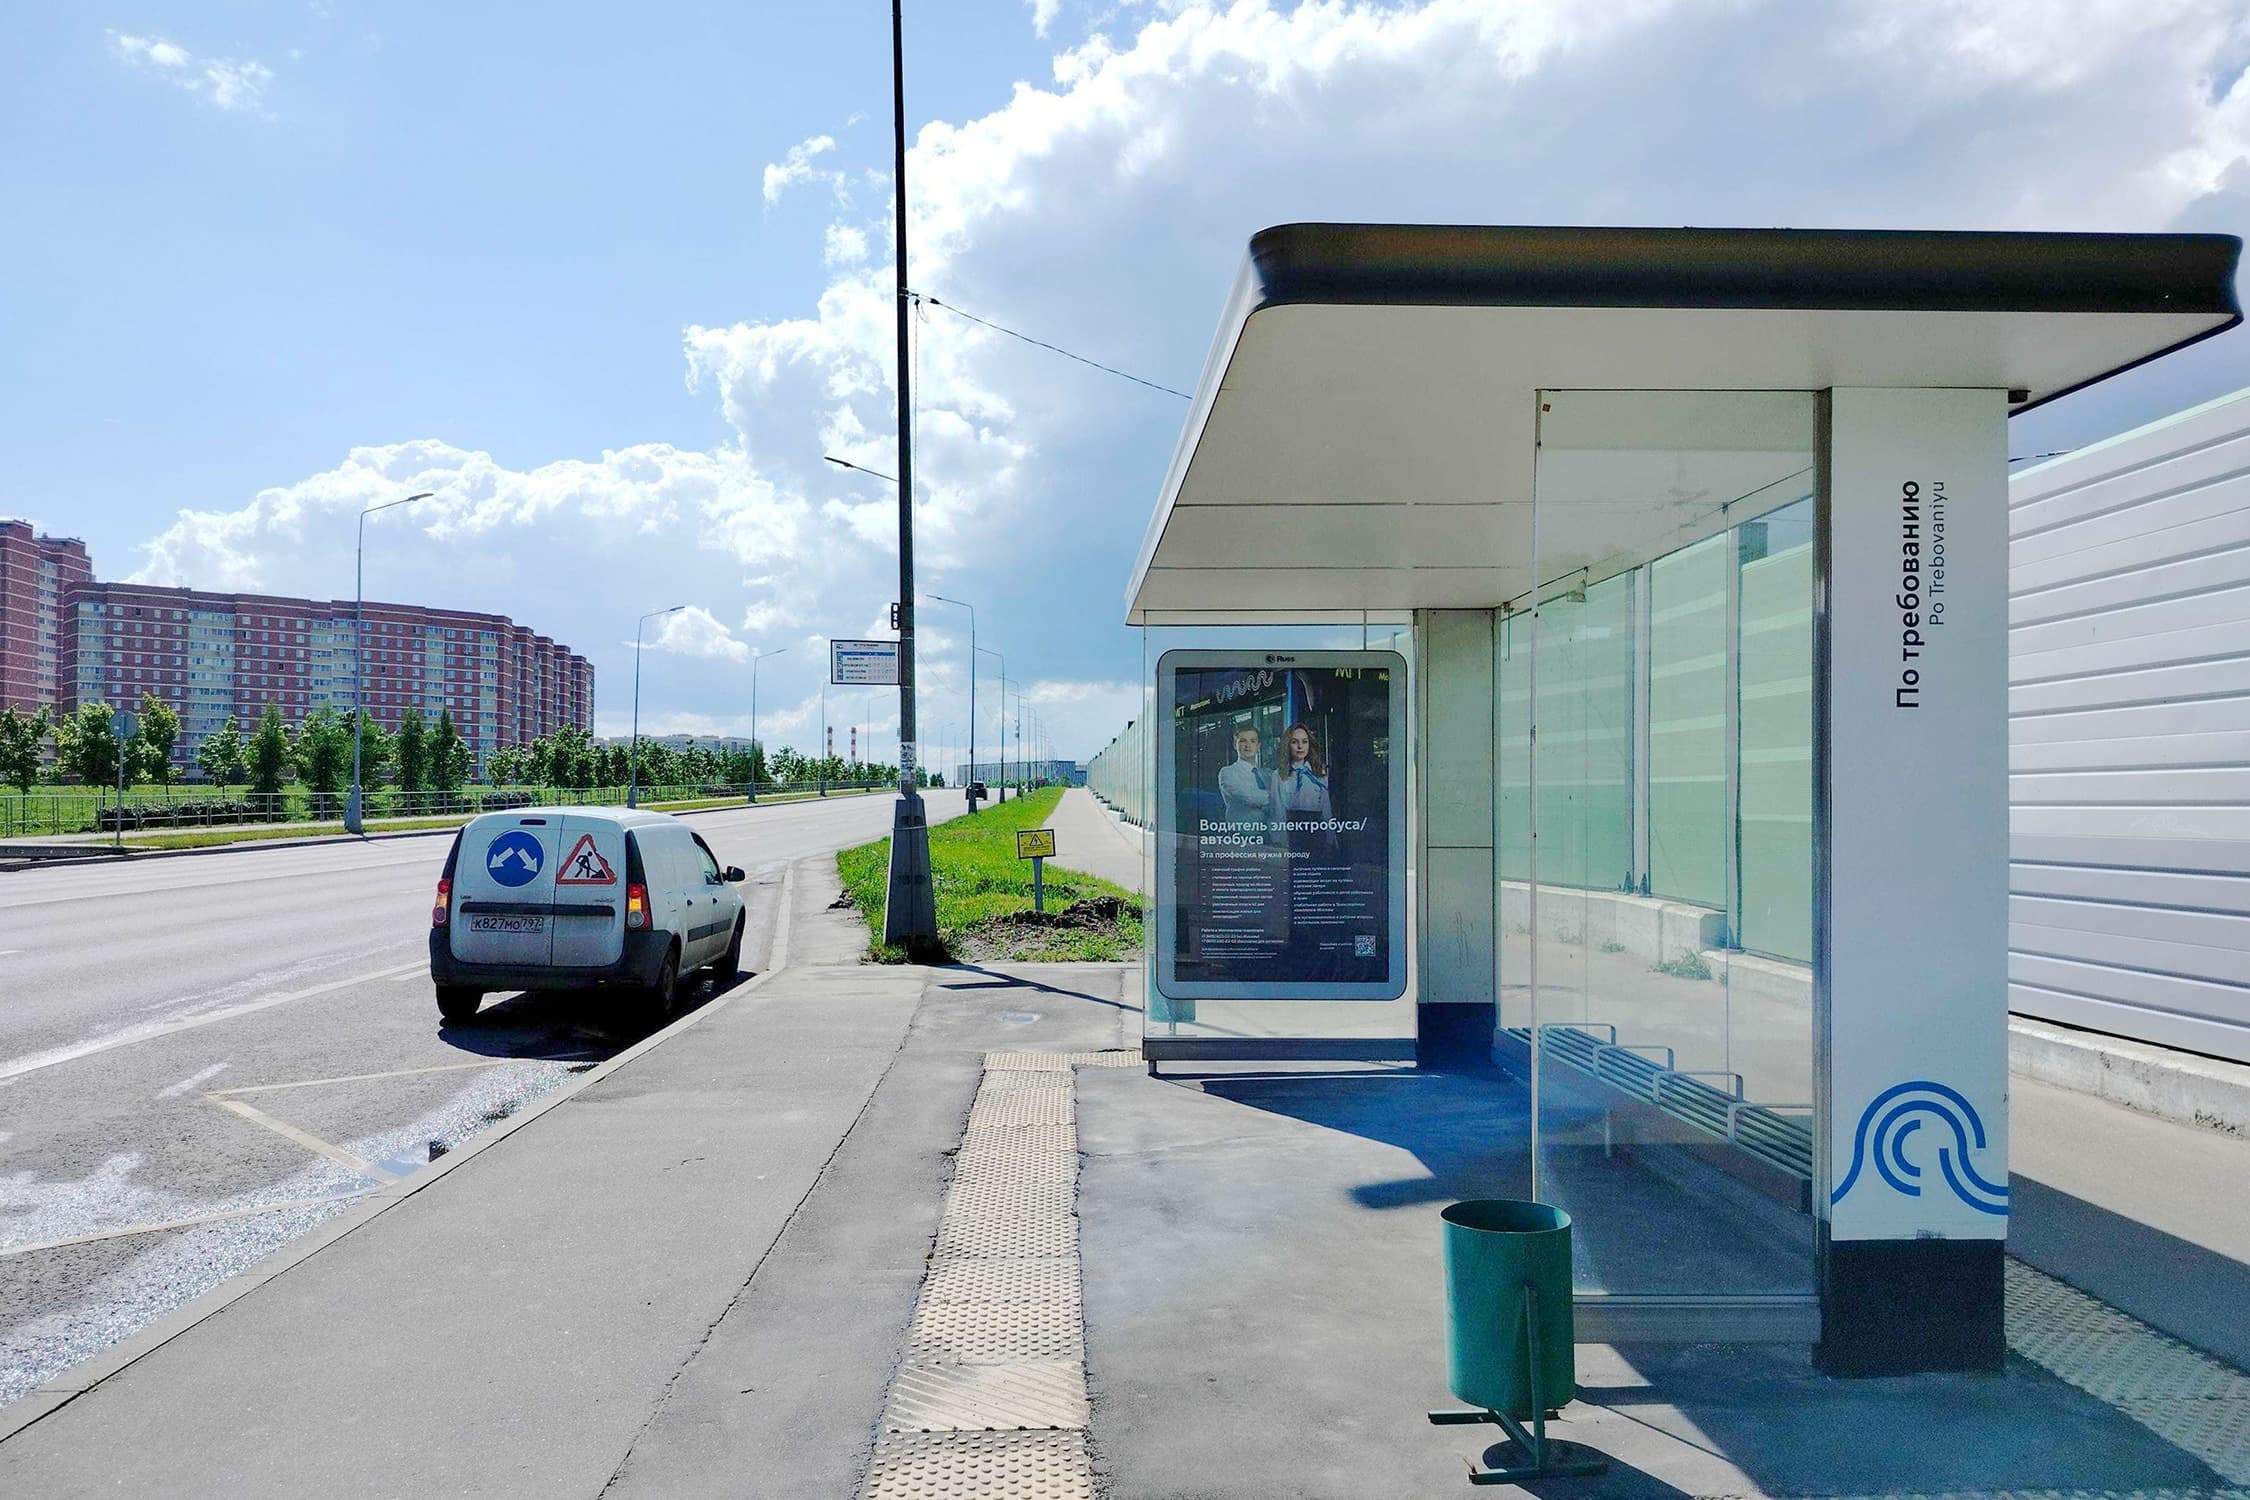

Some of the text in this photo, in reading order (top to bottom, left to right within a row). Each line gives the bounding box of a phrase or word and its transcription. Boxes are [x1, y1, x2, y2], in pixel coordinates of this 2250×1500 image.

[1928, 482, 1948, 625] Po Trebovaniyu
[1896, 481, 1925, 708] По требованию
[1200, 817, 1368, 833] Водитель электробуса/
[1200, 833, 1264, 848] автобуса
[1200, 851, 1311, 860] Эта профессия нужна городу
